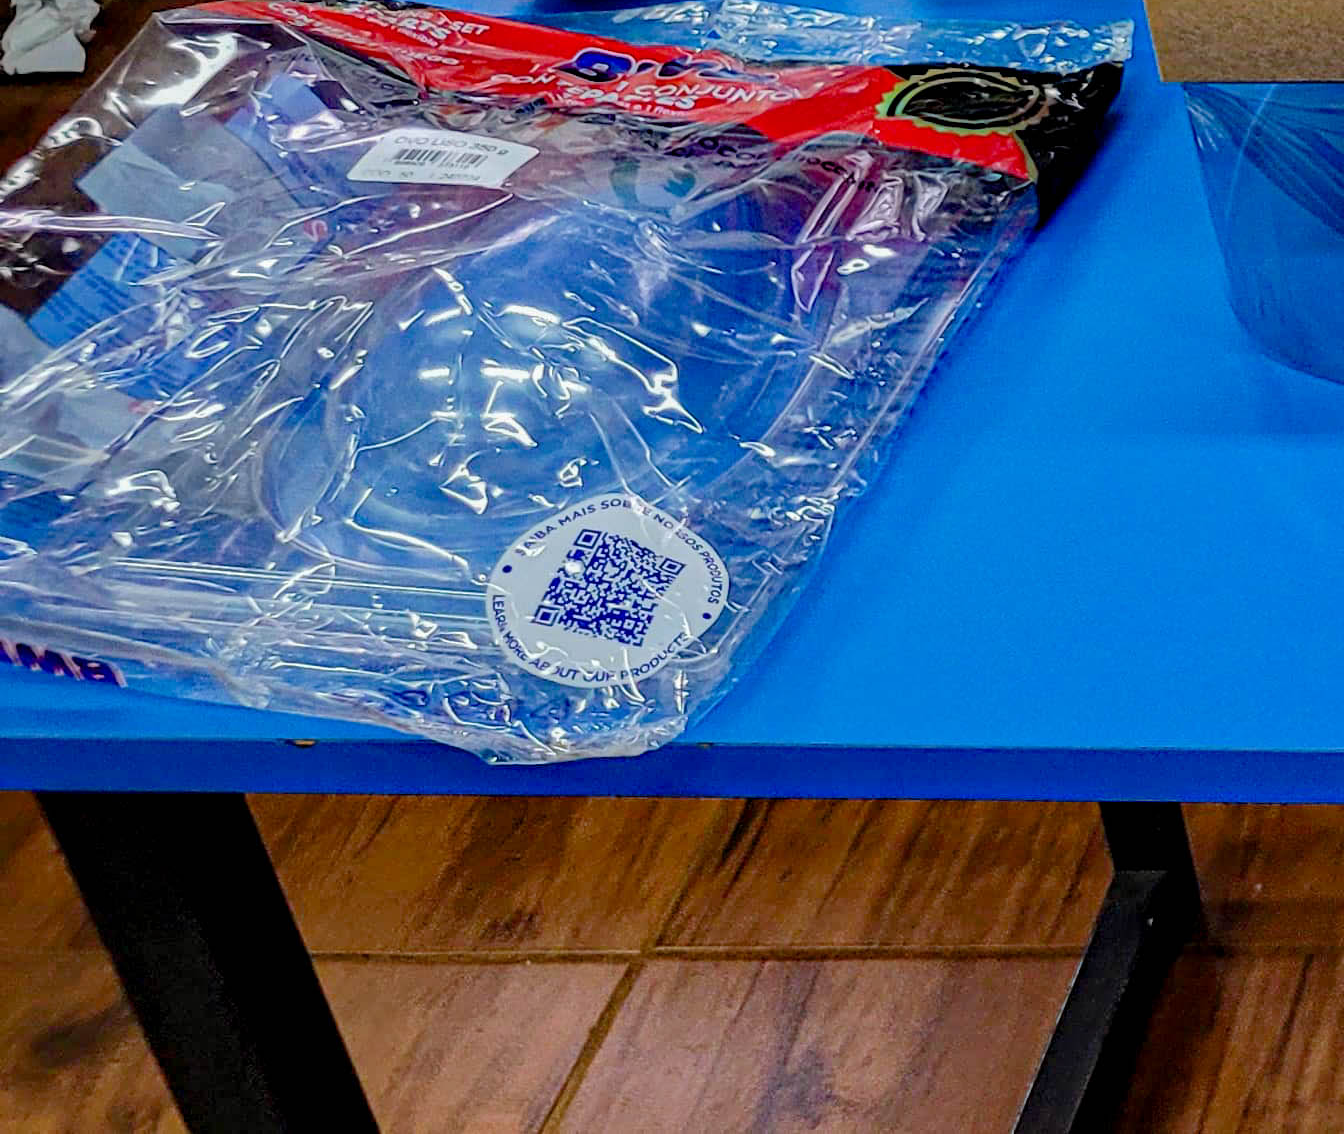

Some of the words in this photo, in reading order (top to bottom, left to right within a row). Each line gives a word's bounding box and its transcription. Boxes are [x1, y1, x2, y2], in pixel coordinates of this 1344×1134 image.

[450, 21, 491, 36] SET
[558, 503, 597, 526] MAIS
[600, 497, 652, 517] SOBE
[699, 550, 724, 605] PRODUTOS
[621, 631, 692, 680] PRODUCTS
